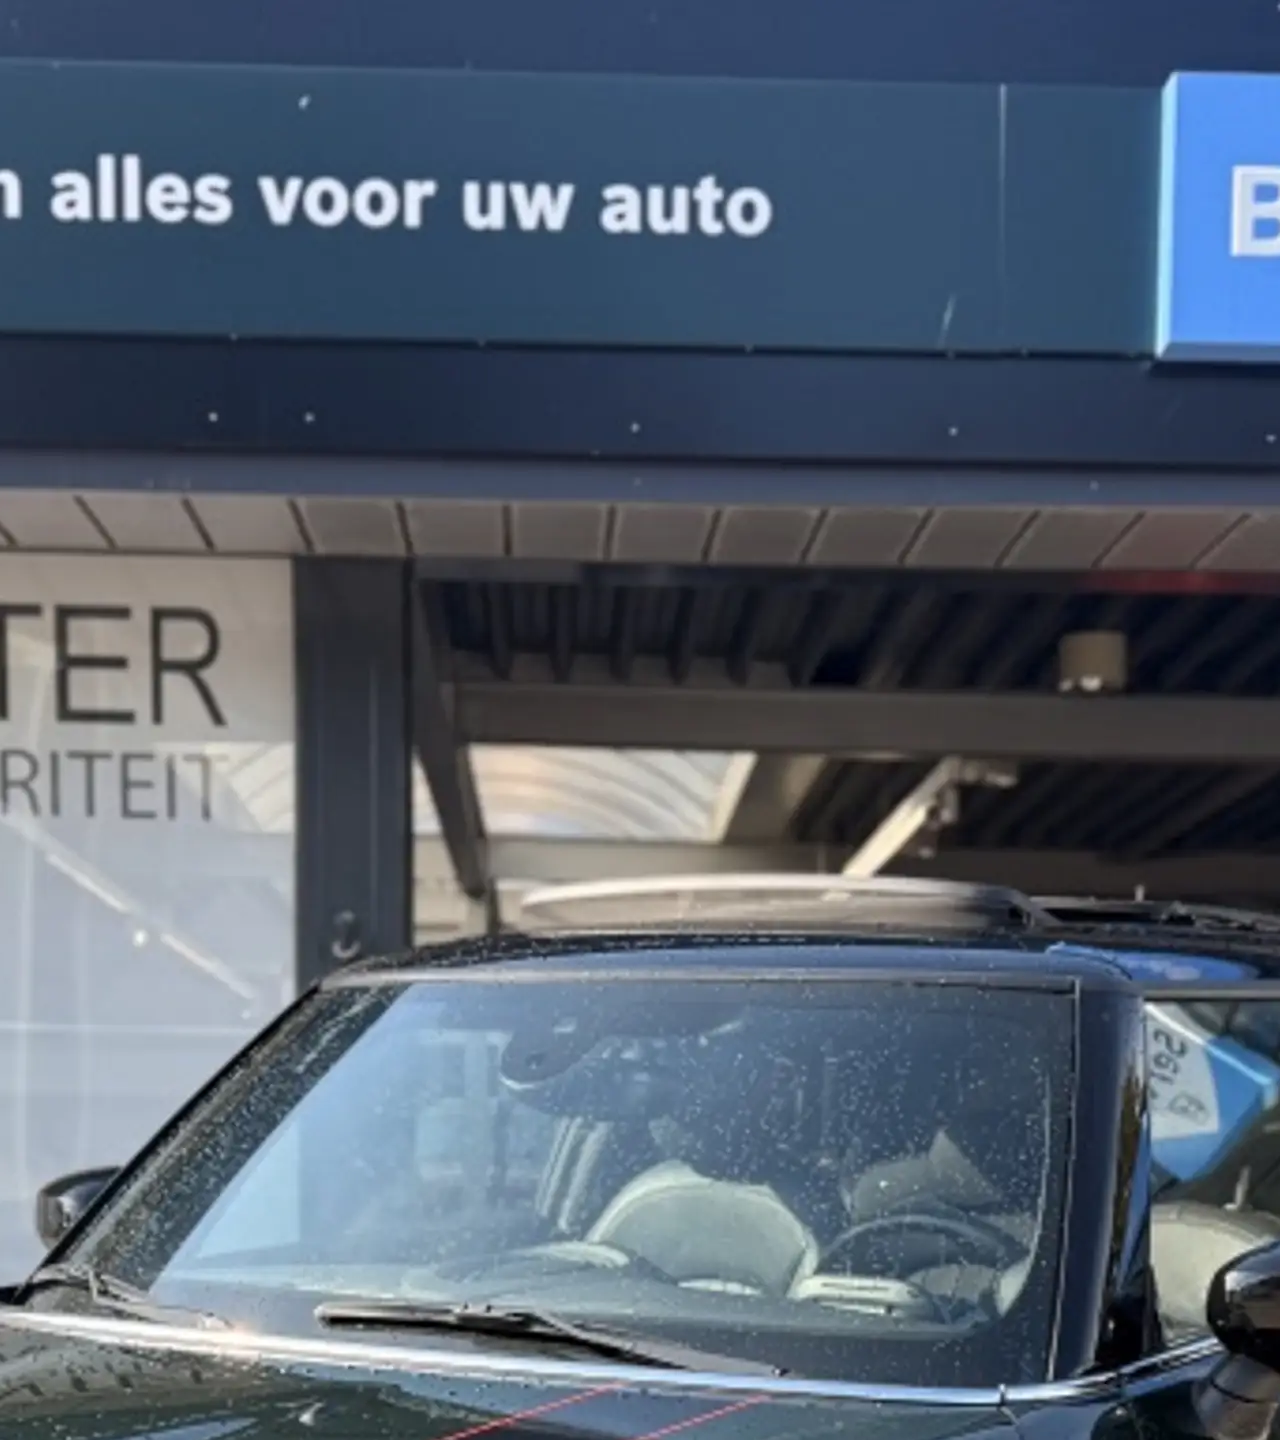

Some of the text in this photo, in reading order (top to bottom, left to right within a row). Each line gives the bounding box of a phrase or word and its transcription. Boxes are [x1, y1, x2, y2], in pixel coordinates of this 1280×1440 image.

[50, 154, 233, 224] alles
[257, 174, 437, 229] voor
[462, 180, 575, 231] uw
[600, 175, 773, 236] auto
